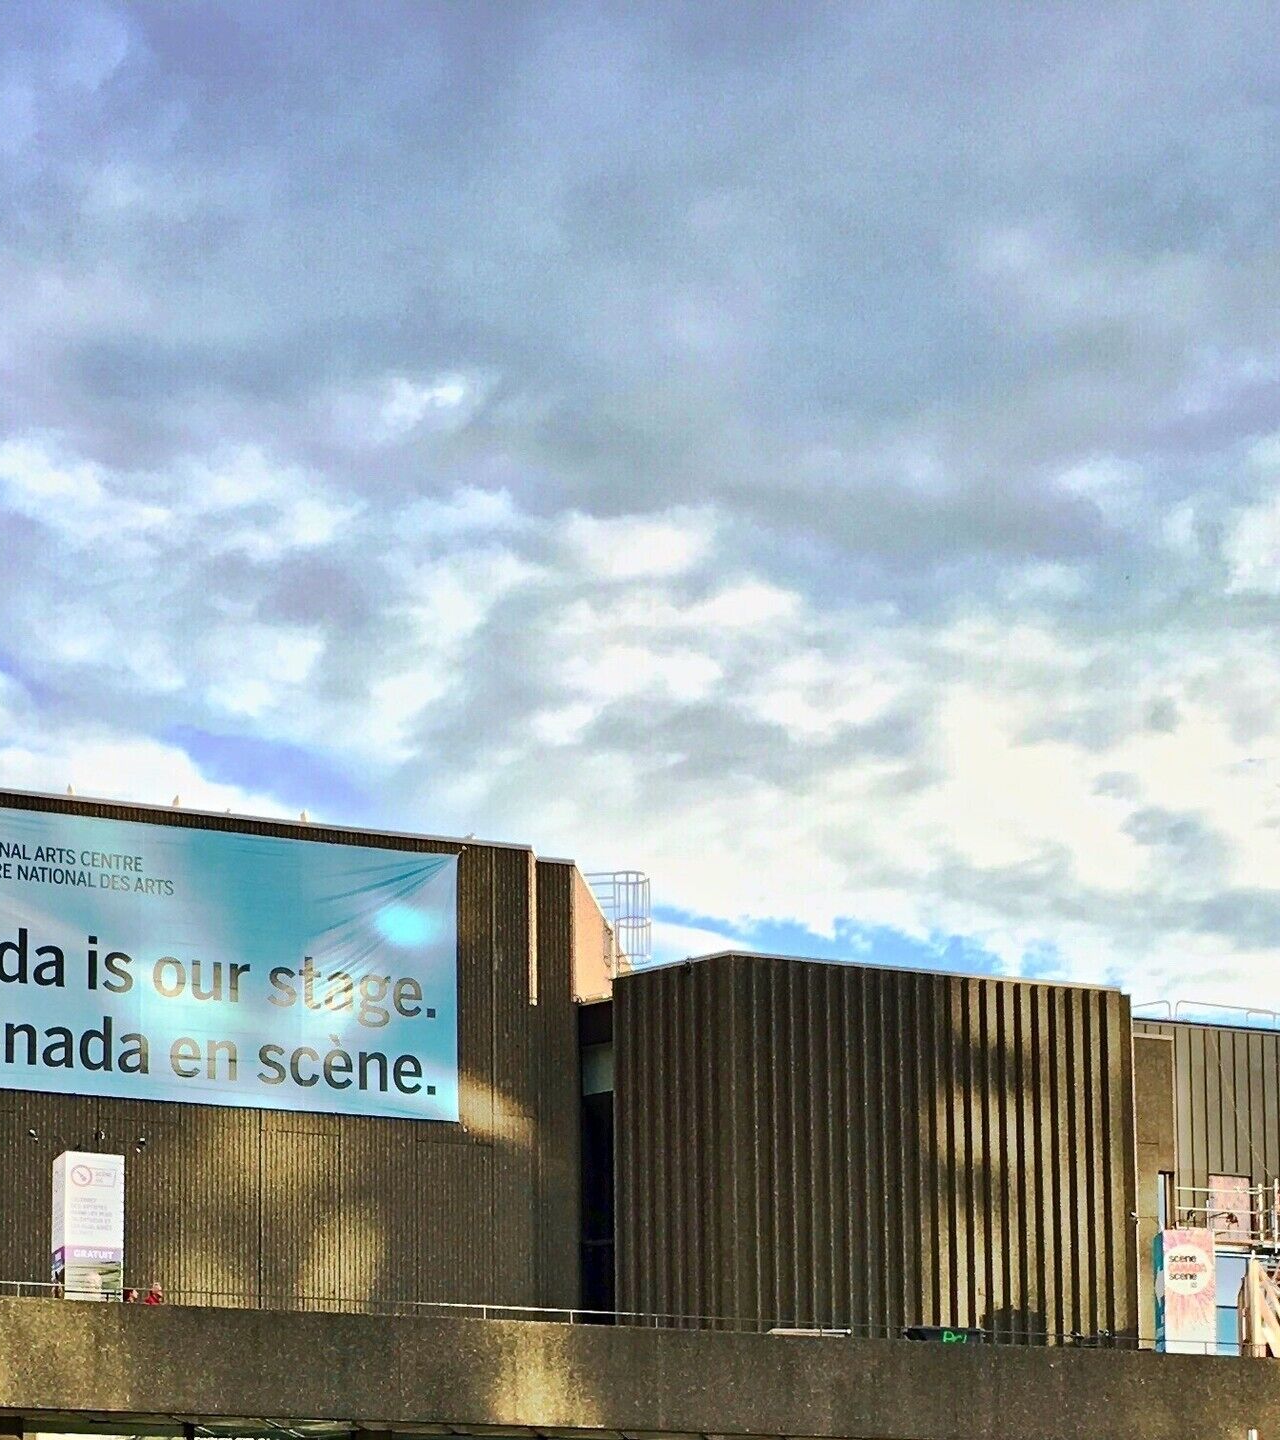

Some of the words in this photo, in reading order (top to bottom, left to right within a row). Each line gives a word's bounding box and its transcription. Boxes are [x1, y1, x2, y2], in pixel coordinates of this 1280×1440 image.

[34, 846, 76, 865] ARTS
[80, 851, 144, 873] CENTRE
[17, 865, 97, 888] NATIONAL
[100, 873, 130, 891] DES
[133, 878, 174, 896] ARTS
[87, 935, 134, 994] is
[152, 956, 251, 1003] our
[267, 956, 436, 1029] stage.
[170, 1036, 238, 1081] en
[256, 1032, 436, 1096] scène.
[73, 1249, 114, 1260] GRATUIT
[1168, 1255, 1197, 1263] scene
[1167, 1263, 1207, 1273] CANADA
[1168, 1273, 1198, 1281] scene
